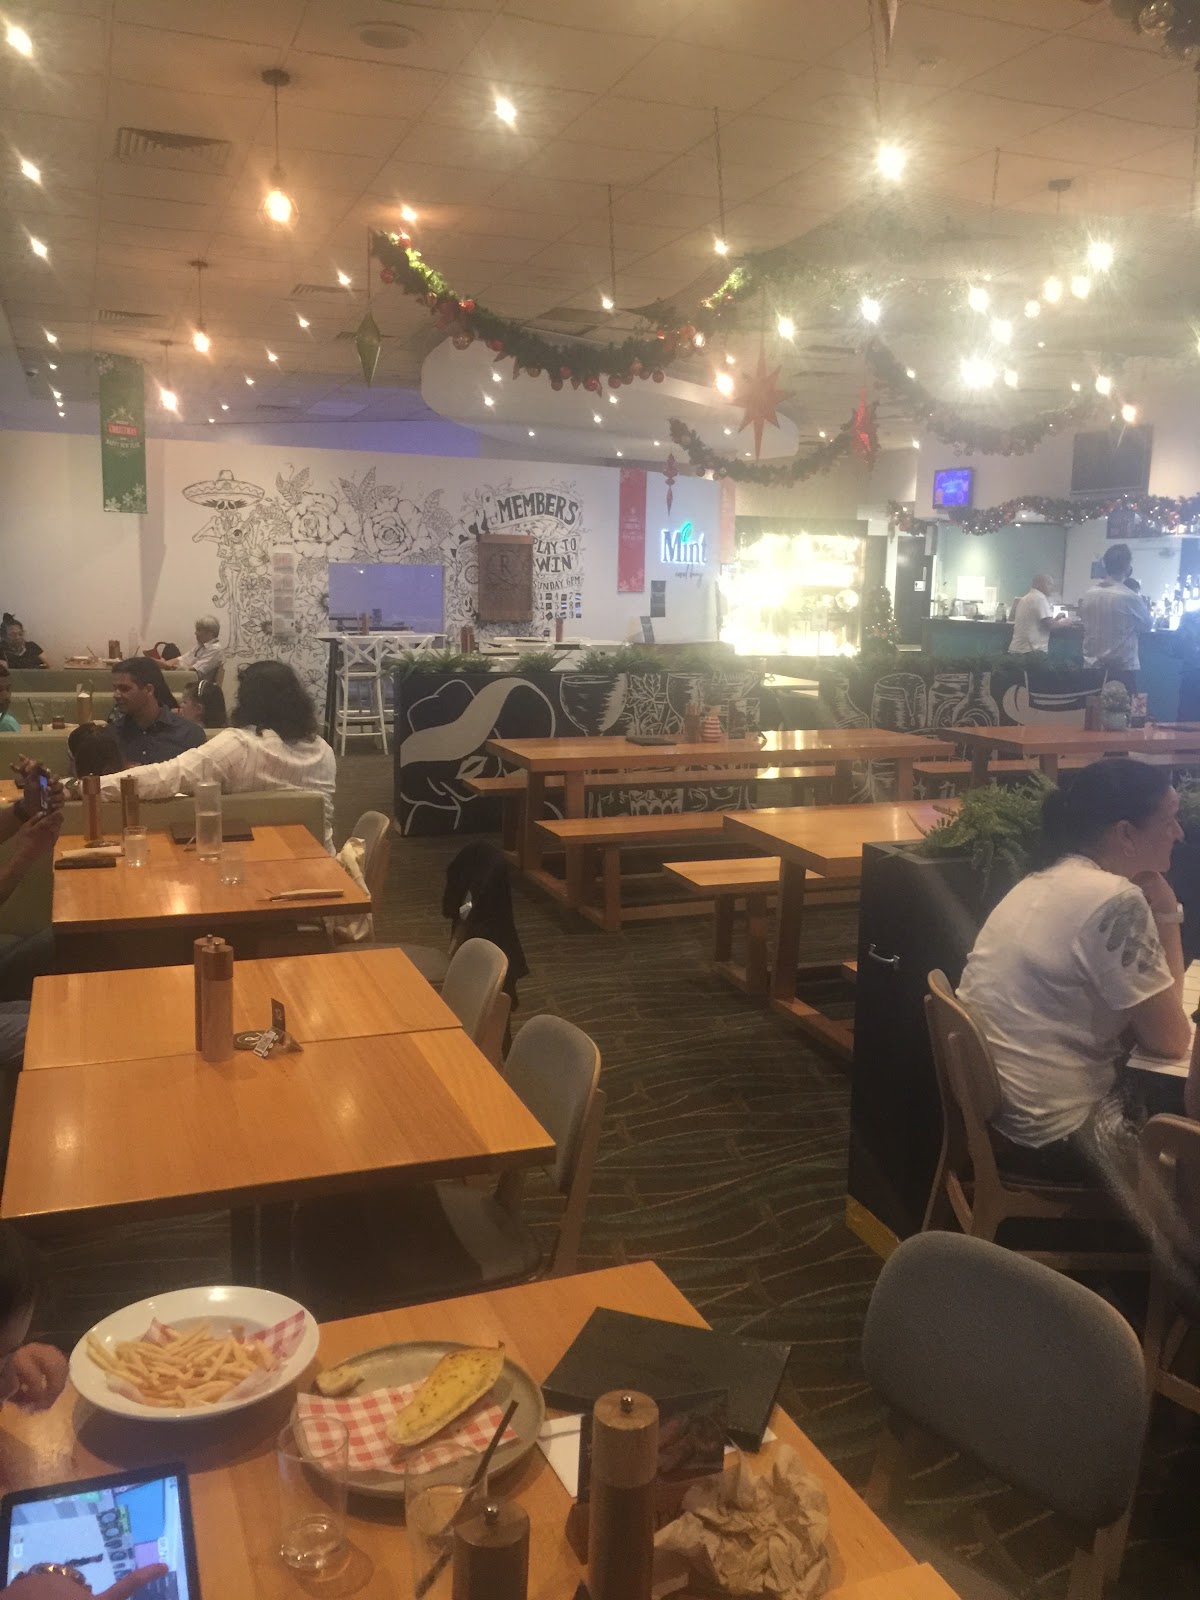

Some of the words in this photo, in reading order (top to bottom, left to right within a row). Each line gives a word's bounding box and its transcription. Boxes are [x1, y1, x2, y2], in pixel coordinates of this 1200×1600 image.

[497, 492, 579, 525] MEMBERS
[562, 538, 577, 552] TO
[661, 523, 708, 564] Mint
[536, 555, 572, 573] WIN
[533, 579, 563, 590] SUNDAY
